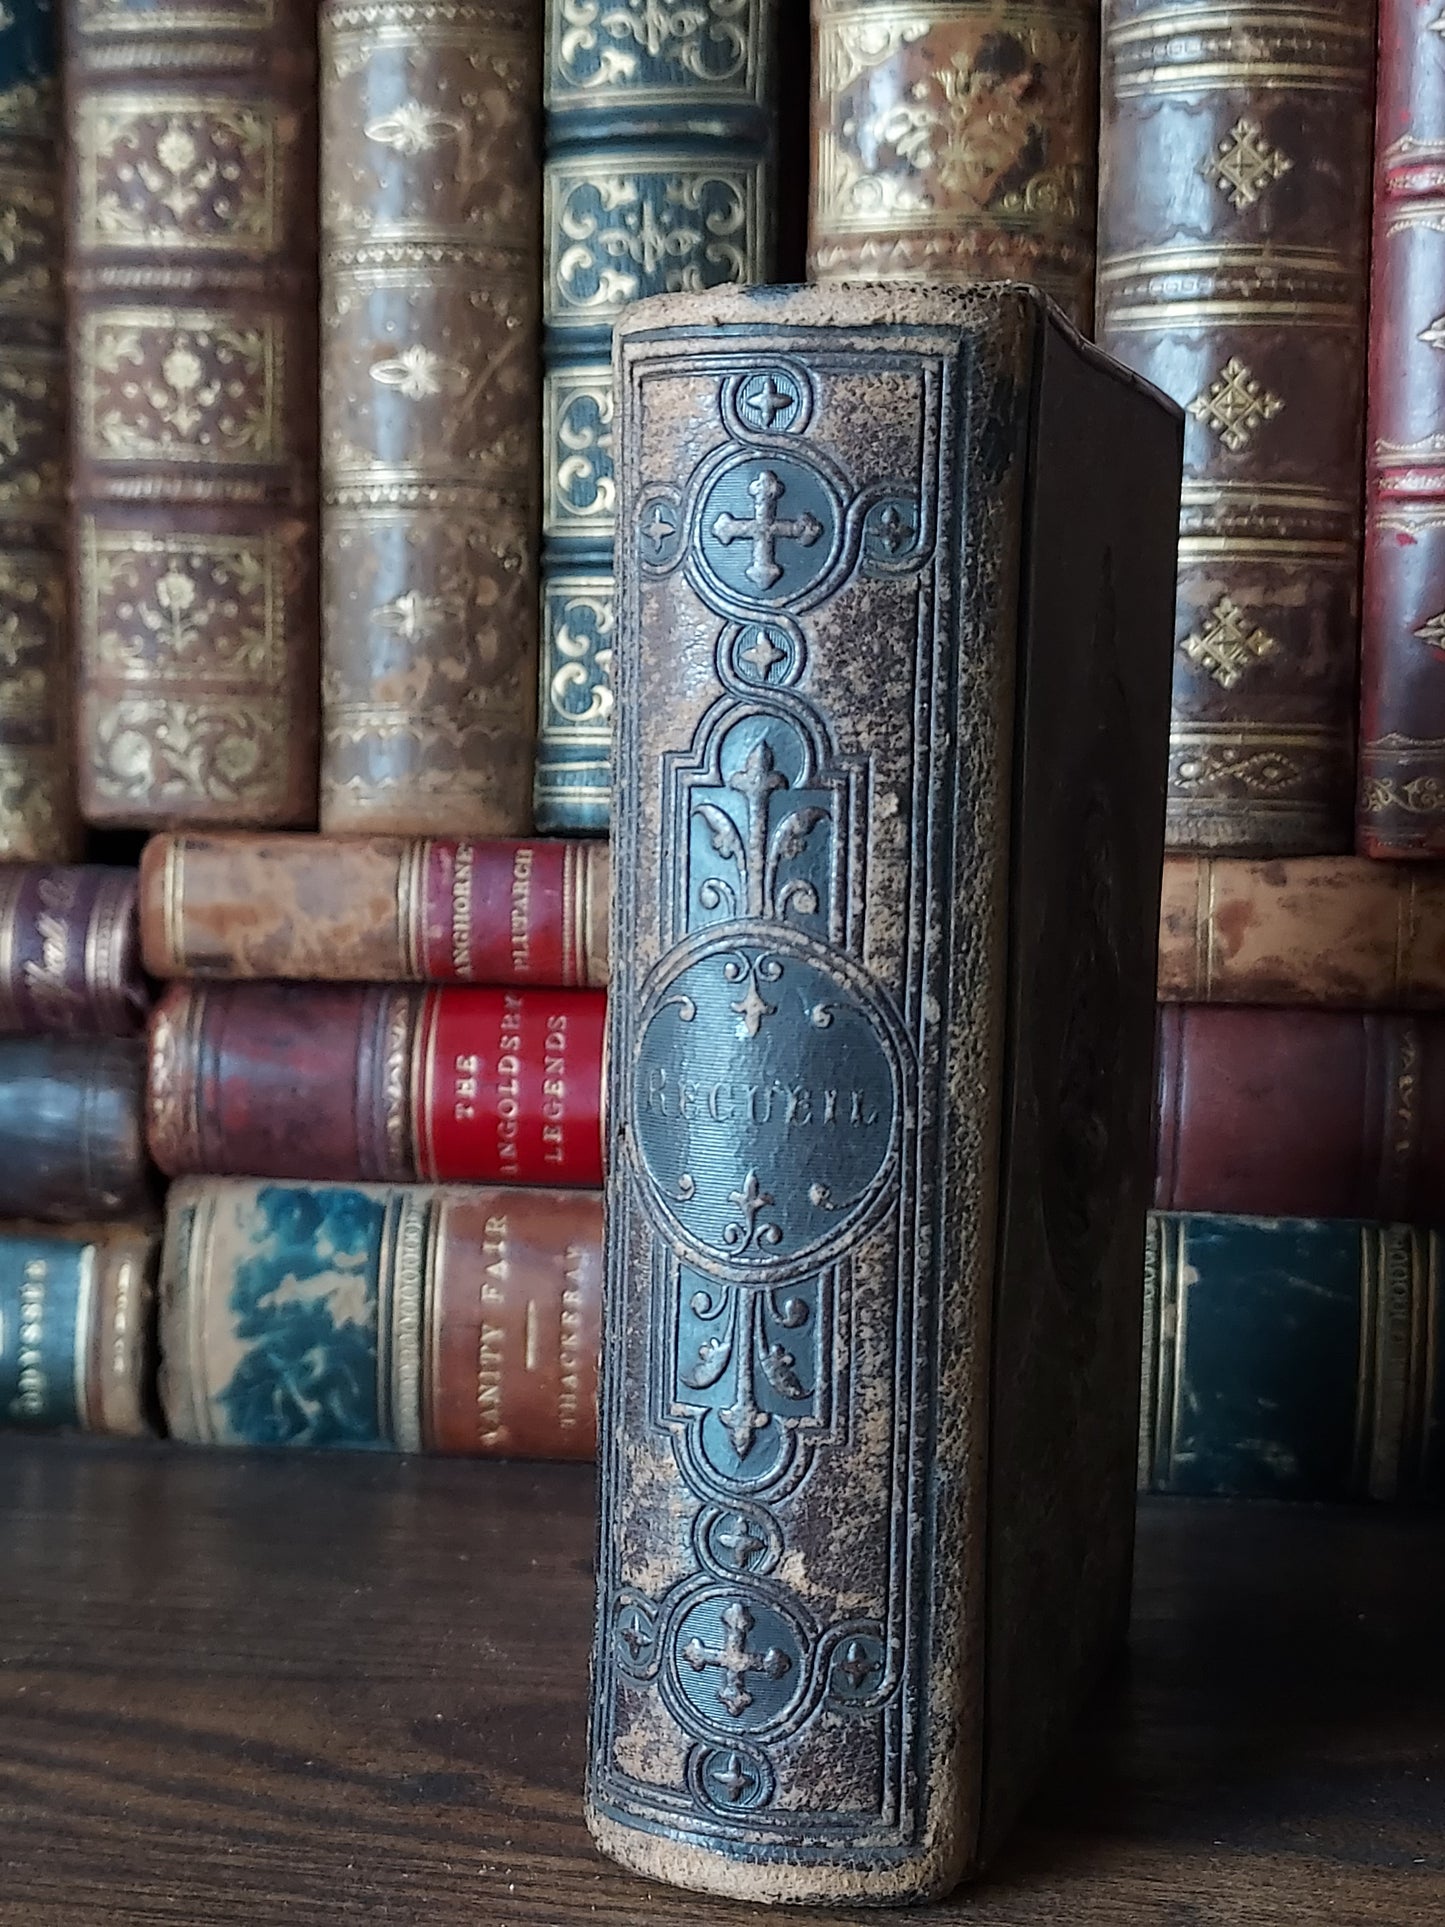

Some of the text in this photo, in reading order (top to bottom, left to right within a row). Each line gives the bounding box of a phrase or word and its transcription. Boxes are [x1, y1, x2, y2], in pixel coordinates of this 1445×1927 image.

[511, 847, 533, 972] PLUTARCH
[455, 1054, 479, 1121] THE
[497, 992, 523, 1177] INGOLDSBY
[543, 1013, 567, 1164] LEGENDS
[477, 1215, 509, 1446] VANITY FAIR
[558, 1246, 583, 1430] THACKERAY
